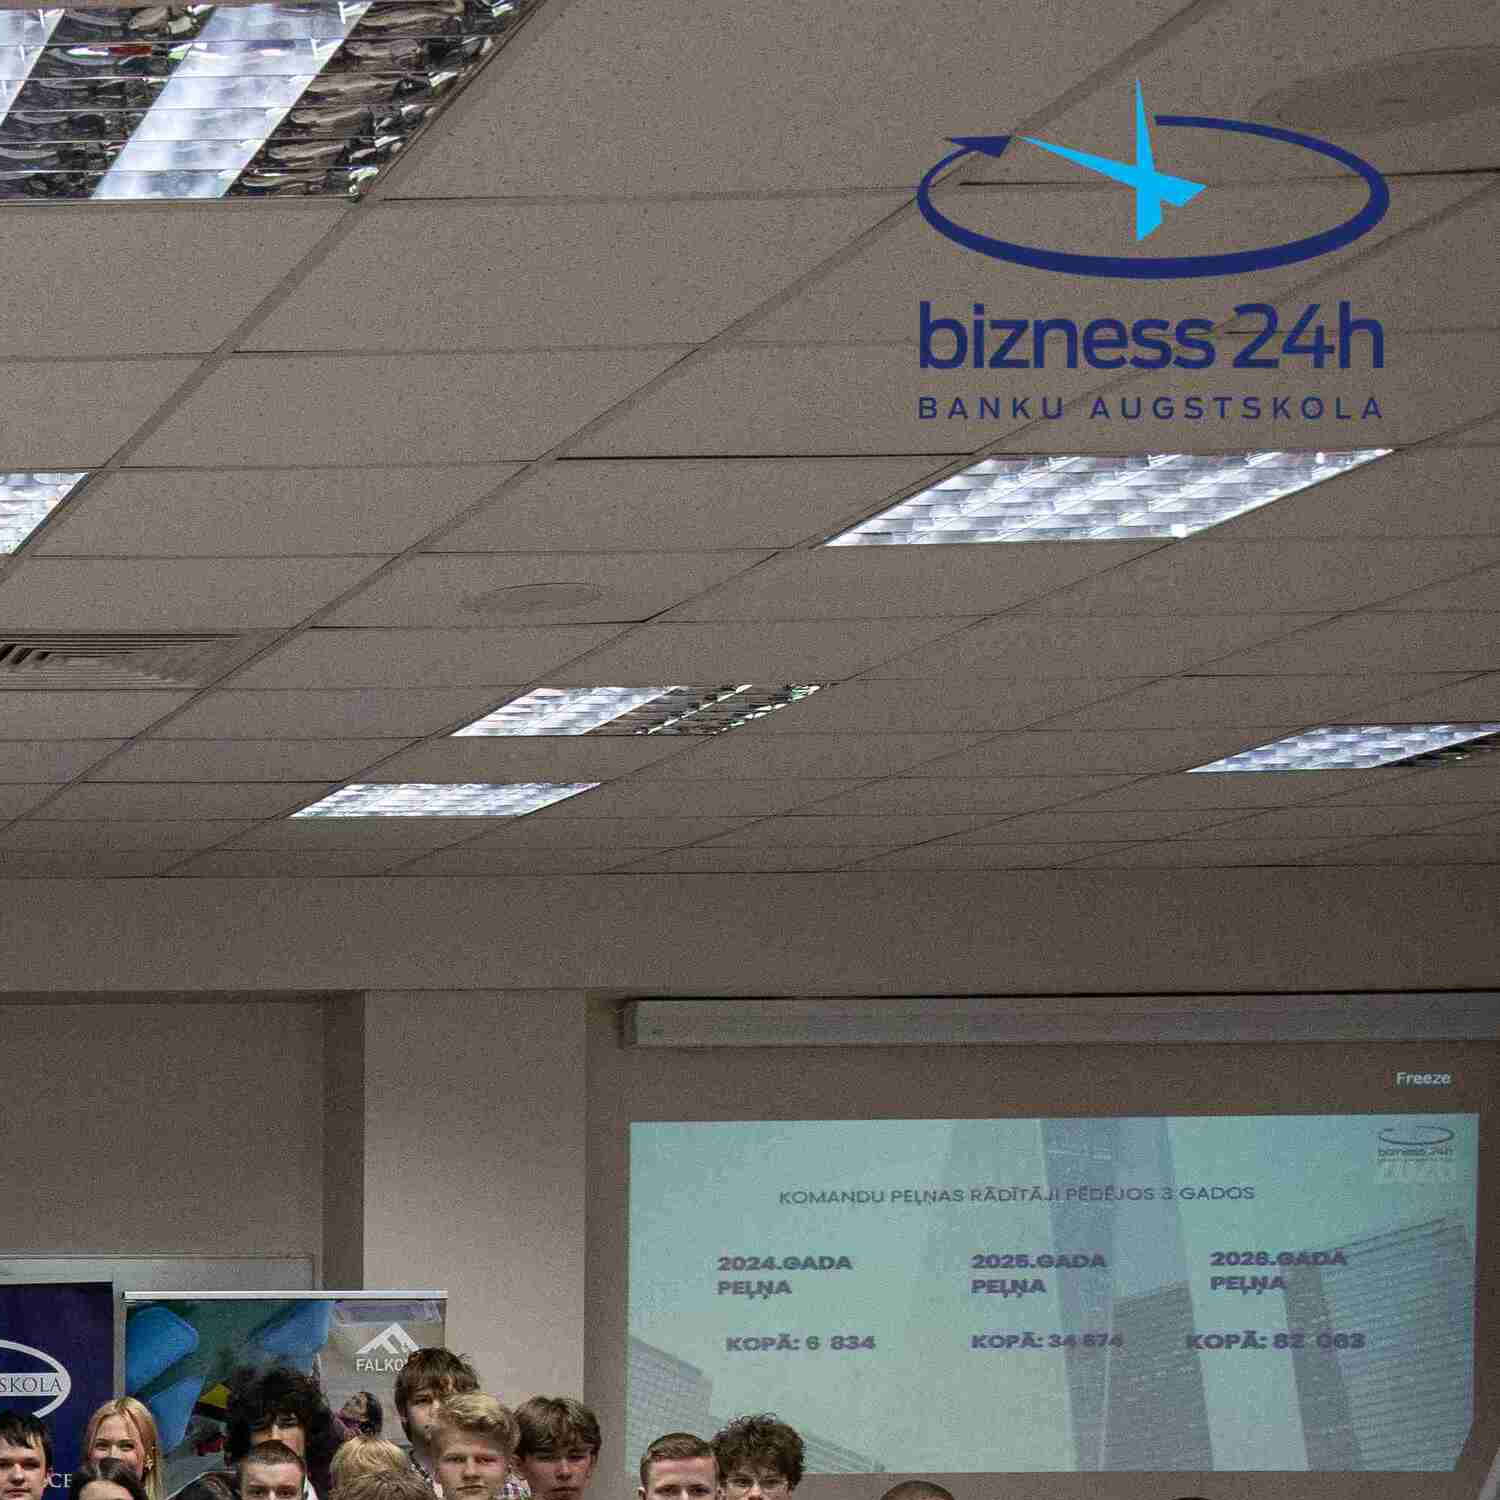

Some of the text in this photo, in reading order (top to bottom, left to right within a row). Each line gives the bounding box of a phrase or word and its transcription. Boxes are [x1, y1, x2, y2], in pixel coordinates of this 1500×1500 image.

[1397, 1072, 1451, 1085] Freeze
[779, 1188, 885, 1205] KOMANDU
[1178, 1184, 1255, 1201] GADOS
[717, 1256, 853, 1271] 2024.GADA
[356, 1359, 407, 1371] FALKO
